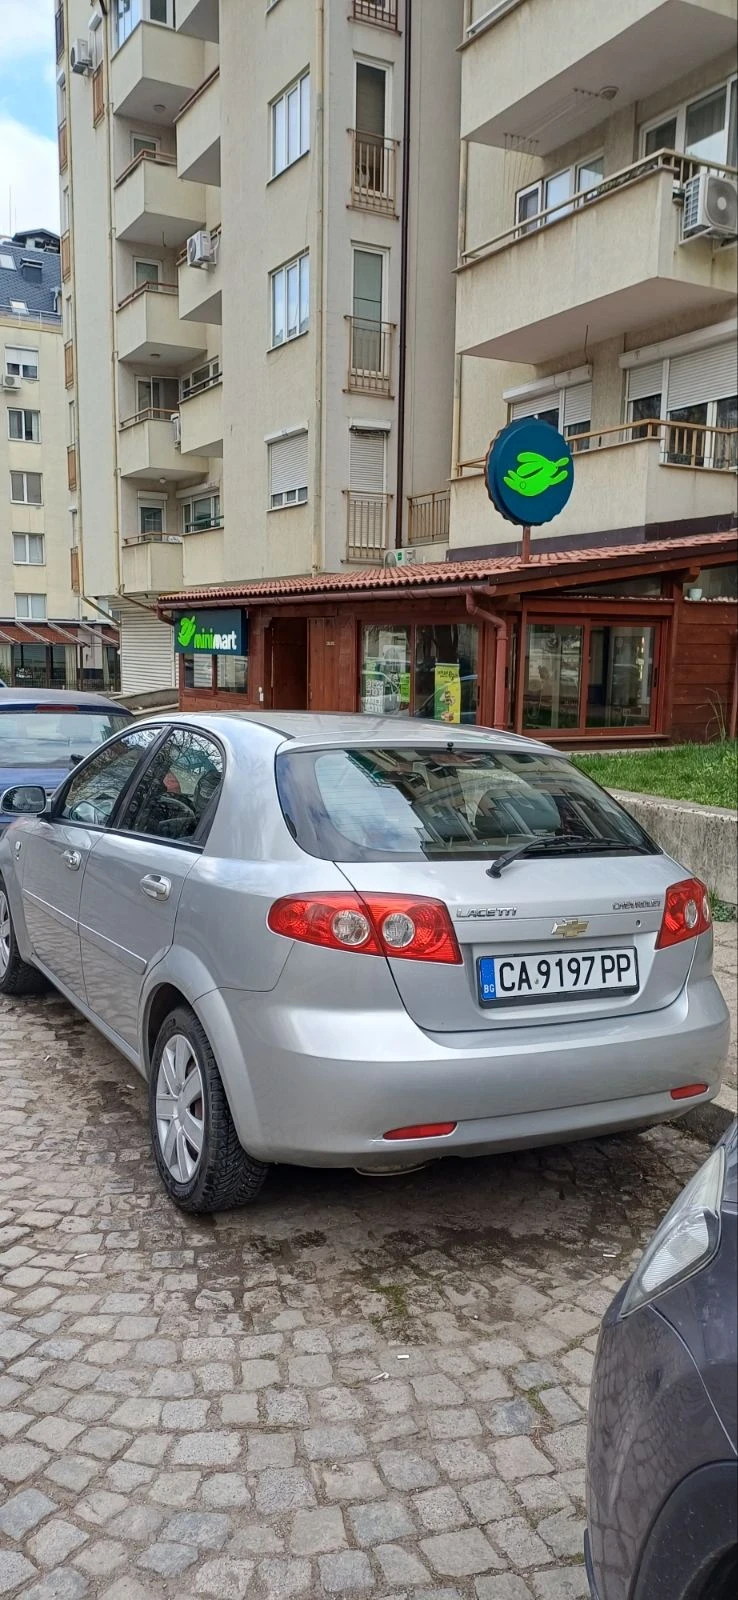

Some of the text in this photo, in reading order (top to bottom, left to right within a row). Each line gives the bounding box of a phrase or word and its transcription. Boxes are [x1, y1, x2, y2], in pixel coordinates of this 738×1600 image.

[194, 628, 237, 650] minimart
[456, 907, 517, 918] LACETTI
[499, 954, 631, 992] CA 9197 PP
[483, 984, 495, 994] BG
